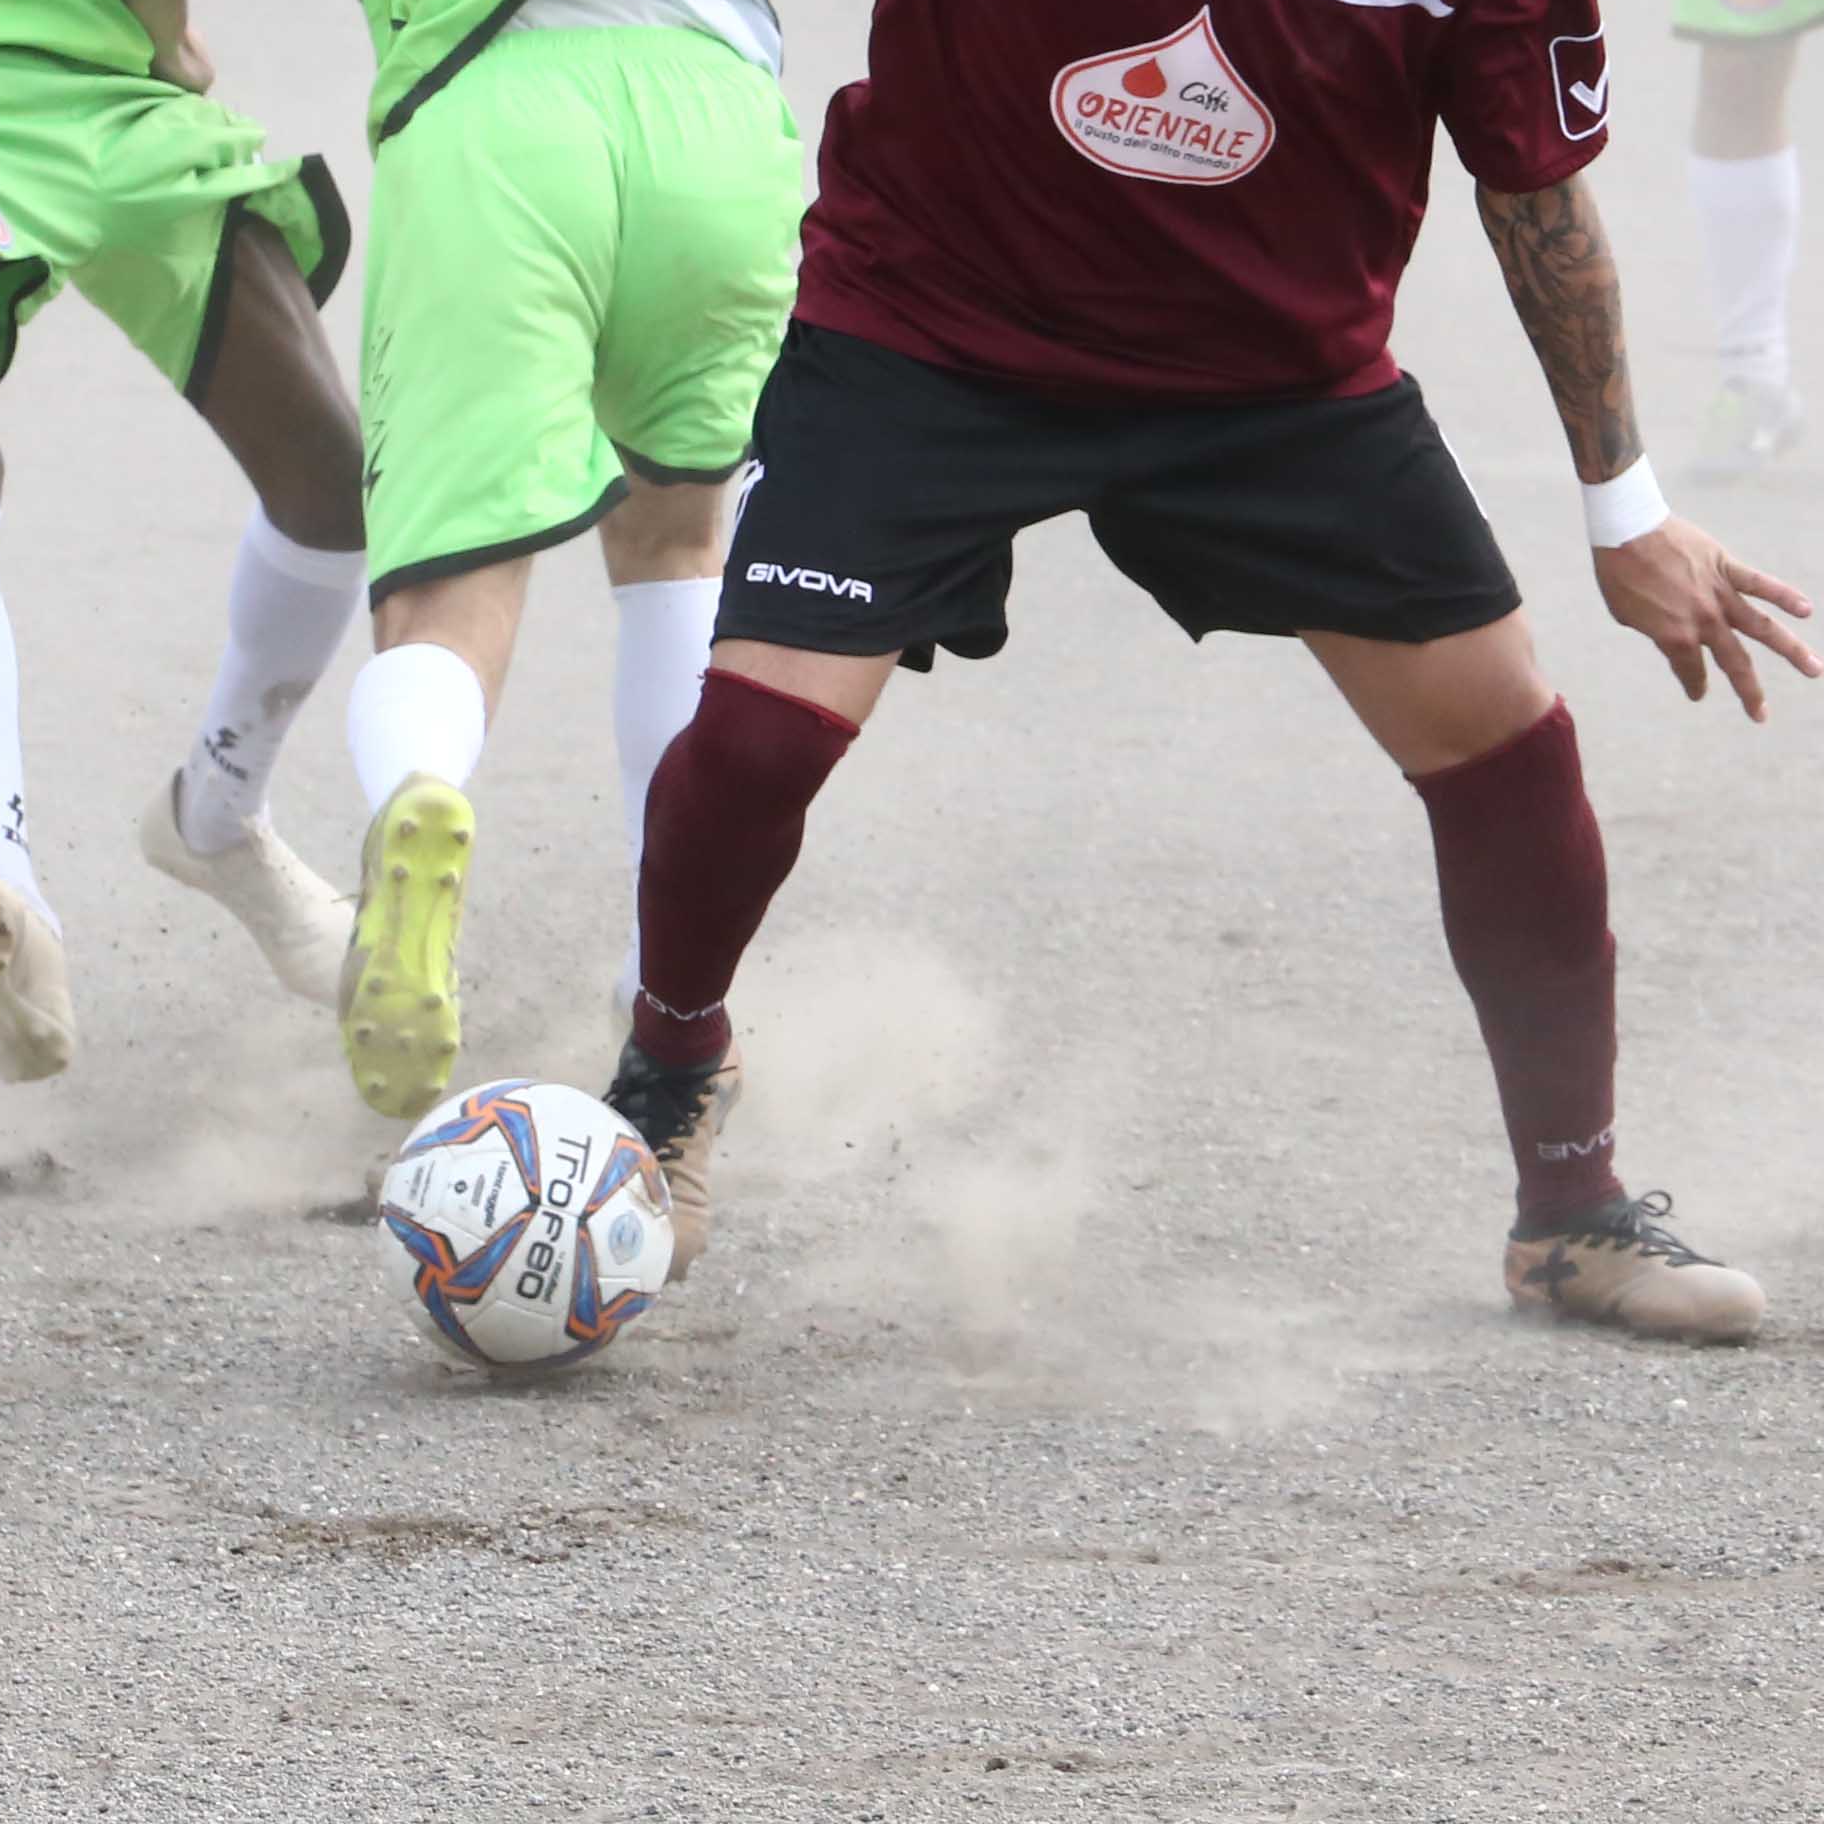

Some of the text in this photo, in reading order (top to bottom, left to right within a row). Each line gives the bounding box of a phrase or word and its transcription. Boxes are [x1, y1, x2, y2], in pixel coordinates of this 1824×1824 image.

[1077, 91, 1254, 159] ORIENTALE
[1084, 124, 1121, 145] gusto
[746, 561, 873, 604] GIVOVA
